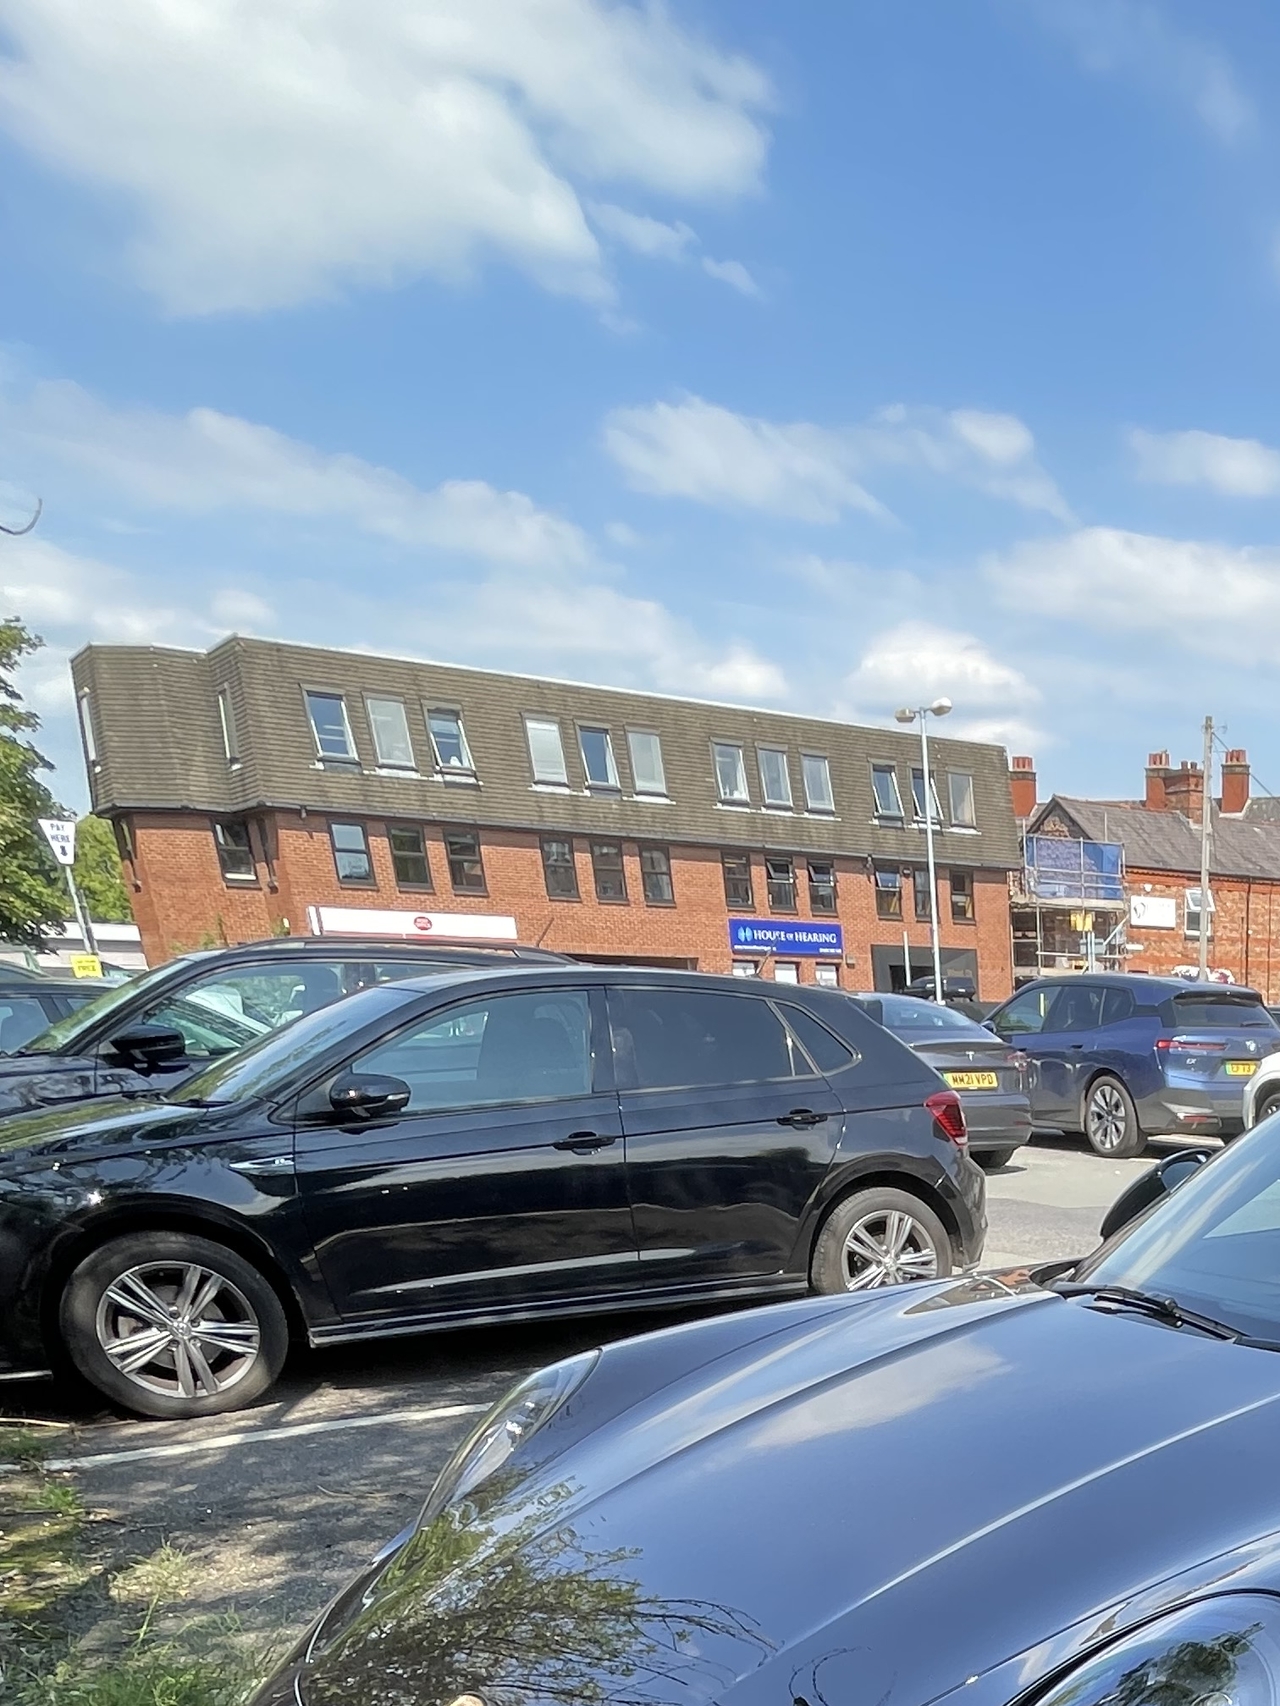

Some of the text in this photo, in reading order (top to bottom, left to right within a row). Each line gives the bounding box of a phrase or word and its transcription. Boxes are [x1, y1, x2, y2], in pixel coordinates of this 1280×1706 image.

[49, 823, 65, 831] PAY
[50, 833, 71, 843] HERE
[753, 929, 786, 941] HOUSE
[794, 931, 837, 943] HEARING
